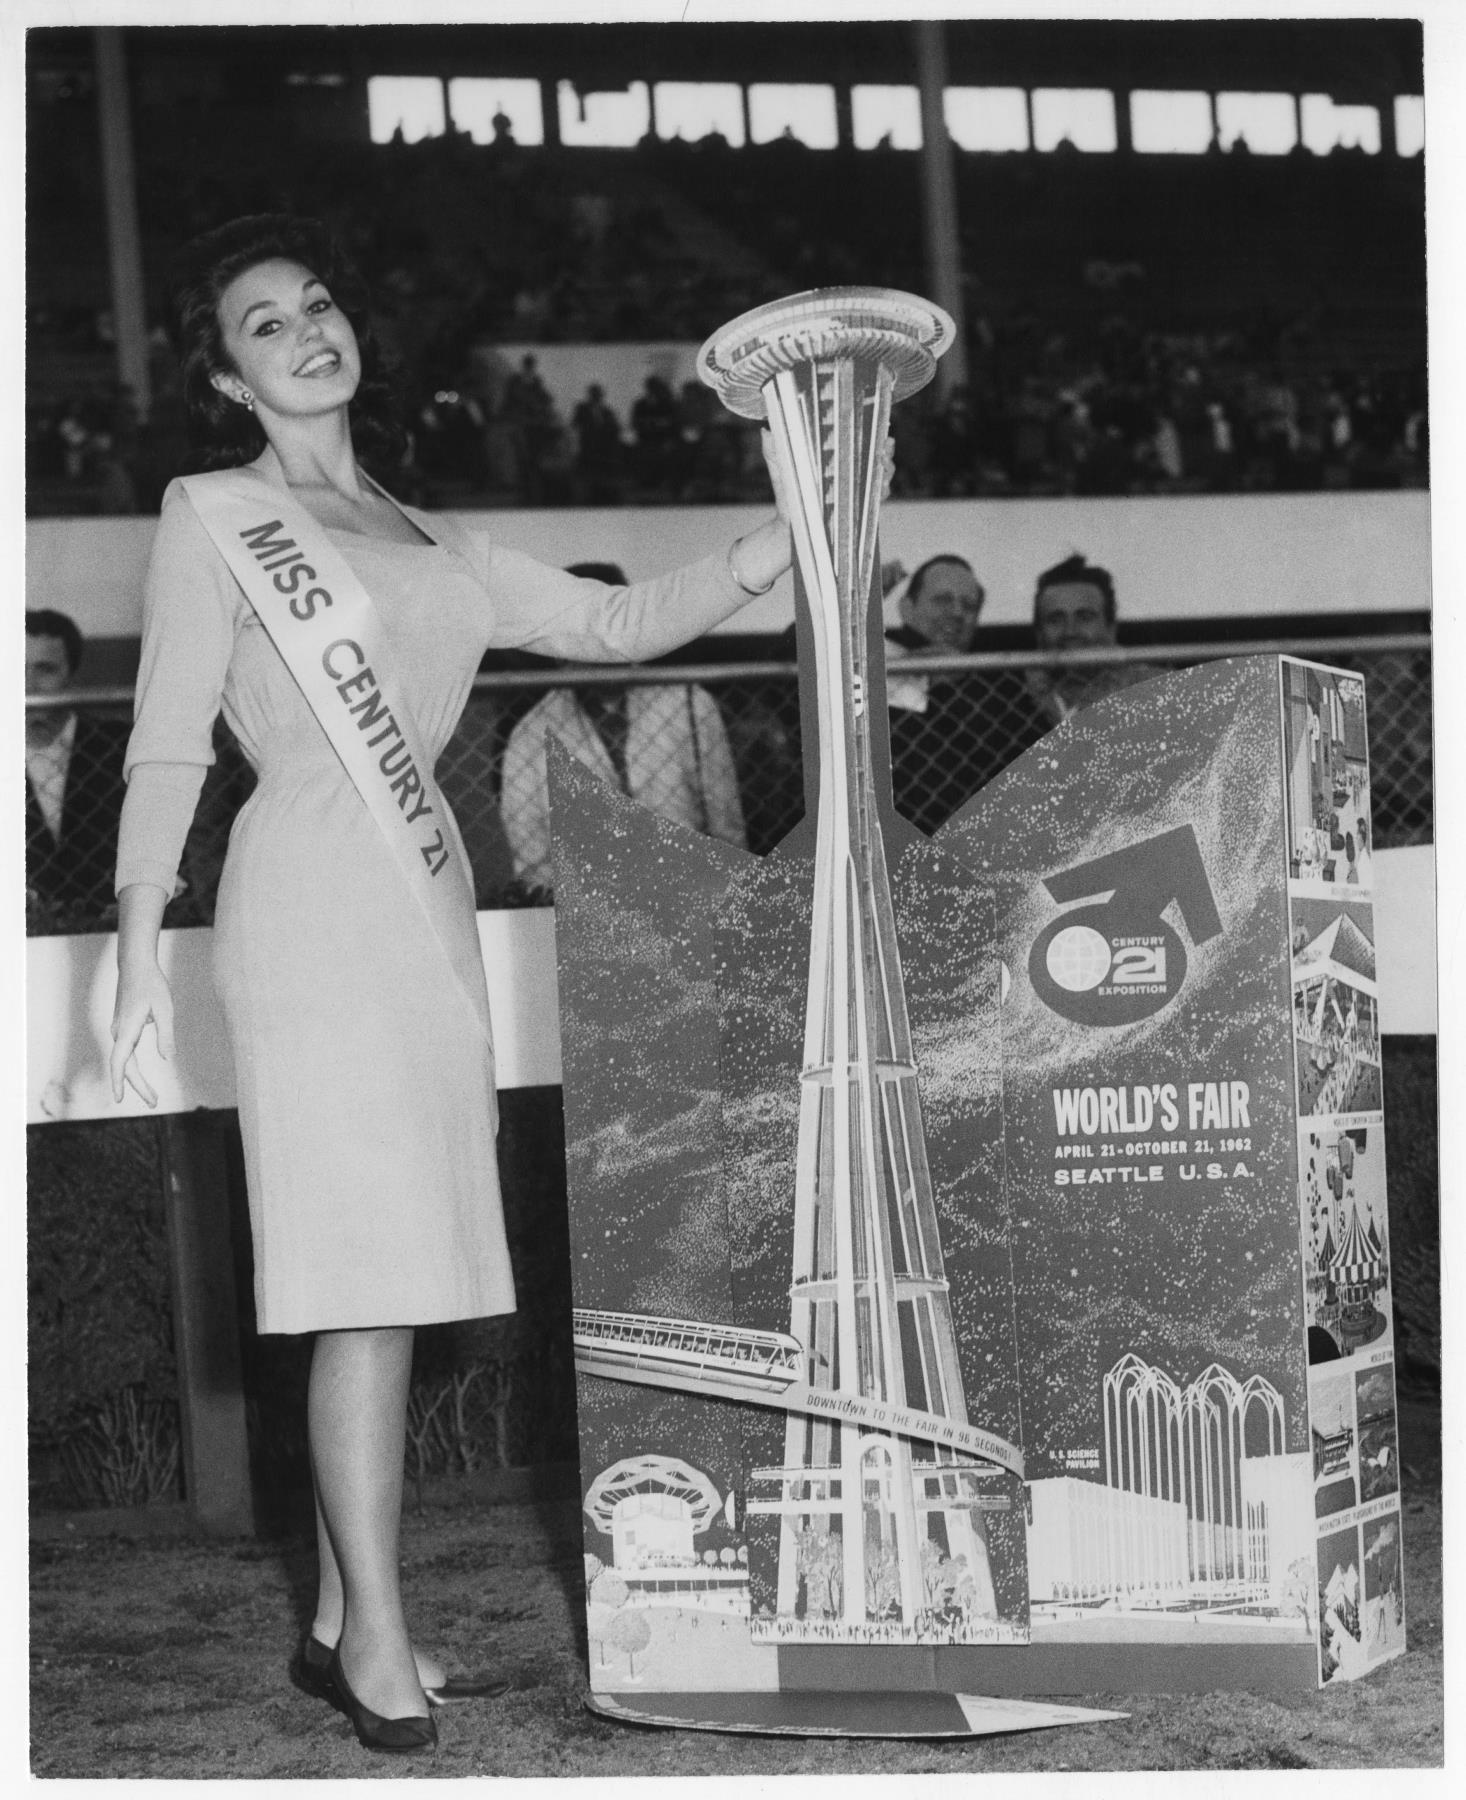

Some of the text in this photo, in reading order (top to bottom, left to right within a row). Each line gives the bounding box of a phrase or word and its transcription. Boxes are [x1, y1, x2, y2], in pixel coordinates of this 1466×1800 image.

[239, 519, 449, 877] MISS CENTURY 21
[1112, 936, 1165, 947] CENTURY
[1112, 946, 1167, 984] 21
[1098, 984, 1167, 996] EXPOSITION
[1053, 1080, 1250, 1136] WORLD'S FAIR
[1054, 1145, 1094, 1159] APRIL
[1195, 1140, 1213, 1154] 21,
[1220, 1138, 1251, 1152] 1962
[1054, 1165, 1164, 1185] SEATTLE
[807, 1394, 867, 1416] DOWNTOWN
[873, 1408, 886, 1421] TO
[892, 1412, 909, 1427] THE
[915, 1420, 938, 1434] FAIR
[943, 1427, 954, 1439] IN
[959, 1431, 970, 1444] 96
[1067, 1448, 1100, 1459] SCIENCE
[1066, 1459, 1100, 1469] PAVILION
